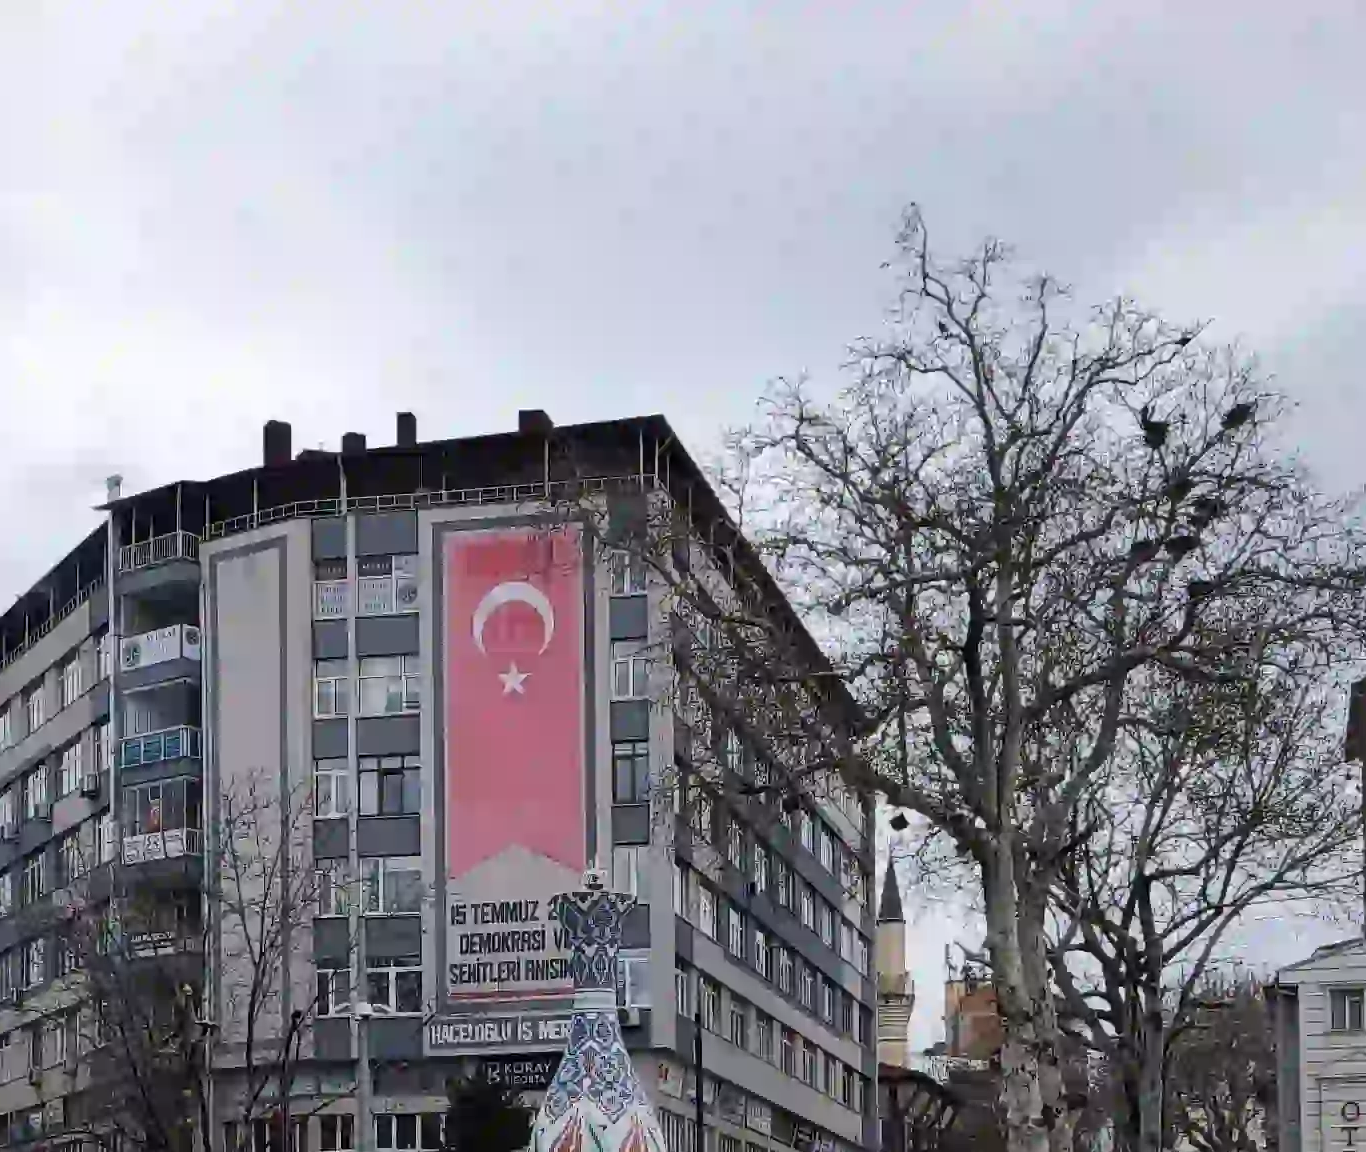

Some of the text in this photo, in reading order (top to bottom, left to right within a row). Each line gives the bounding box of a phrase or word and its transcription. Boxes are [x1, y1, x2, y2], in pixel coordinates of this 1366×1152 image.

[451, 903, 468, 925] 15
[471, 899, 540, 925] TEMMUZ
[459, 924, 546, 956] DEMOKRASİ
[504, 1061, 553, 1075] KORAY
